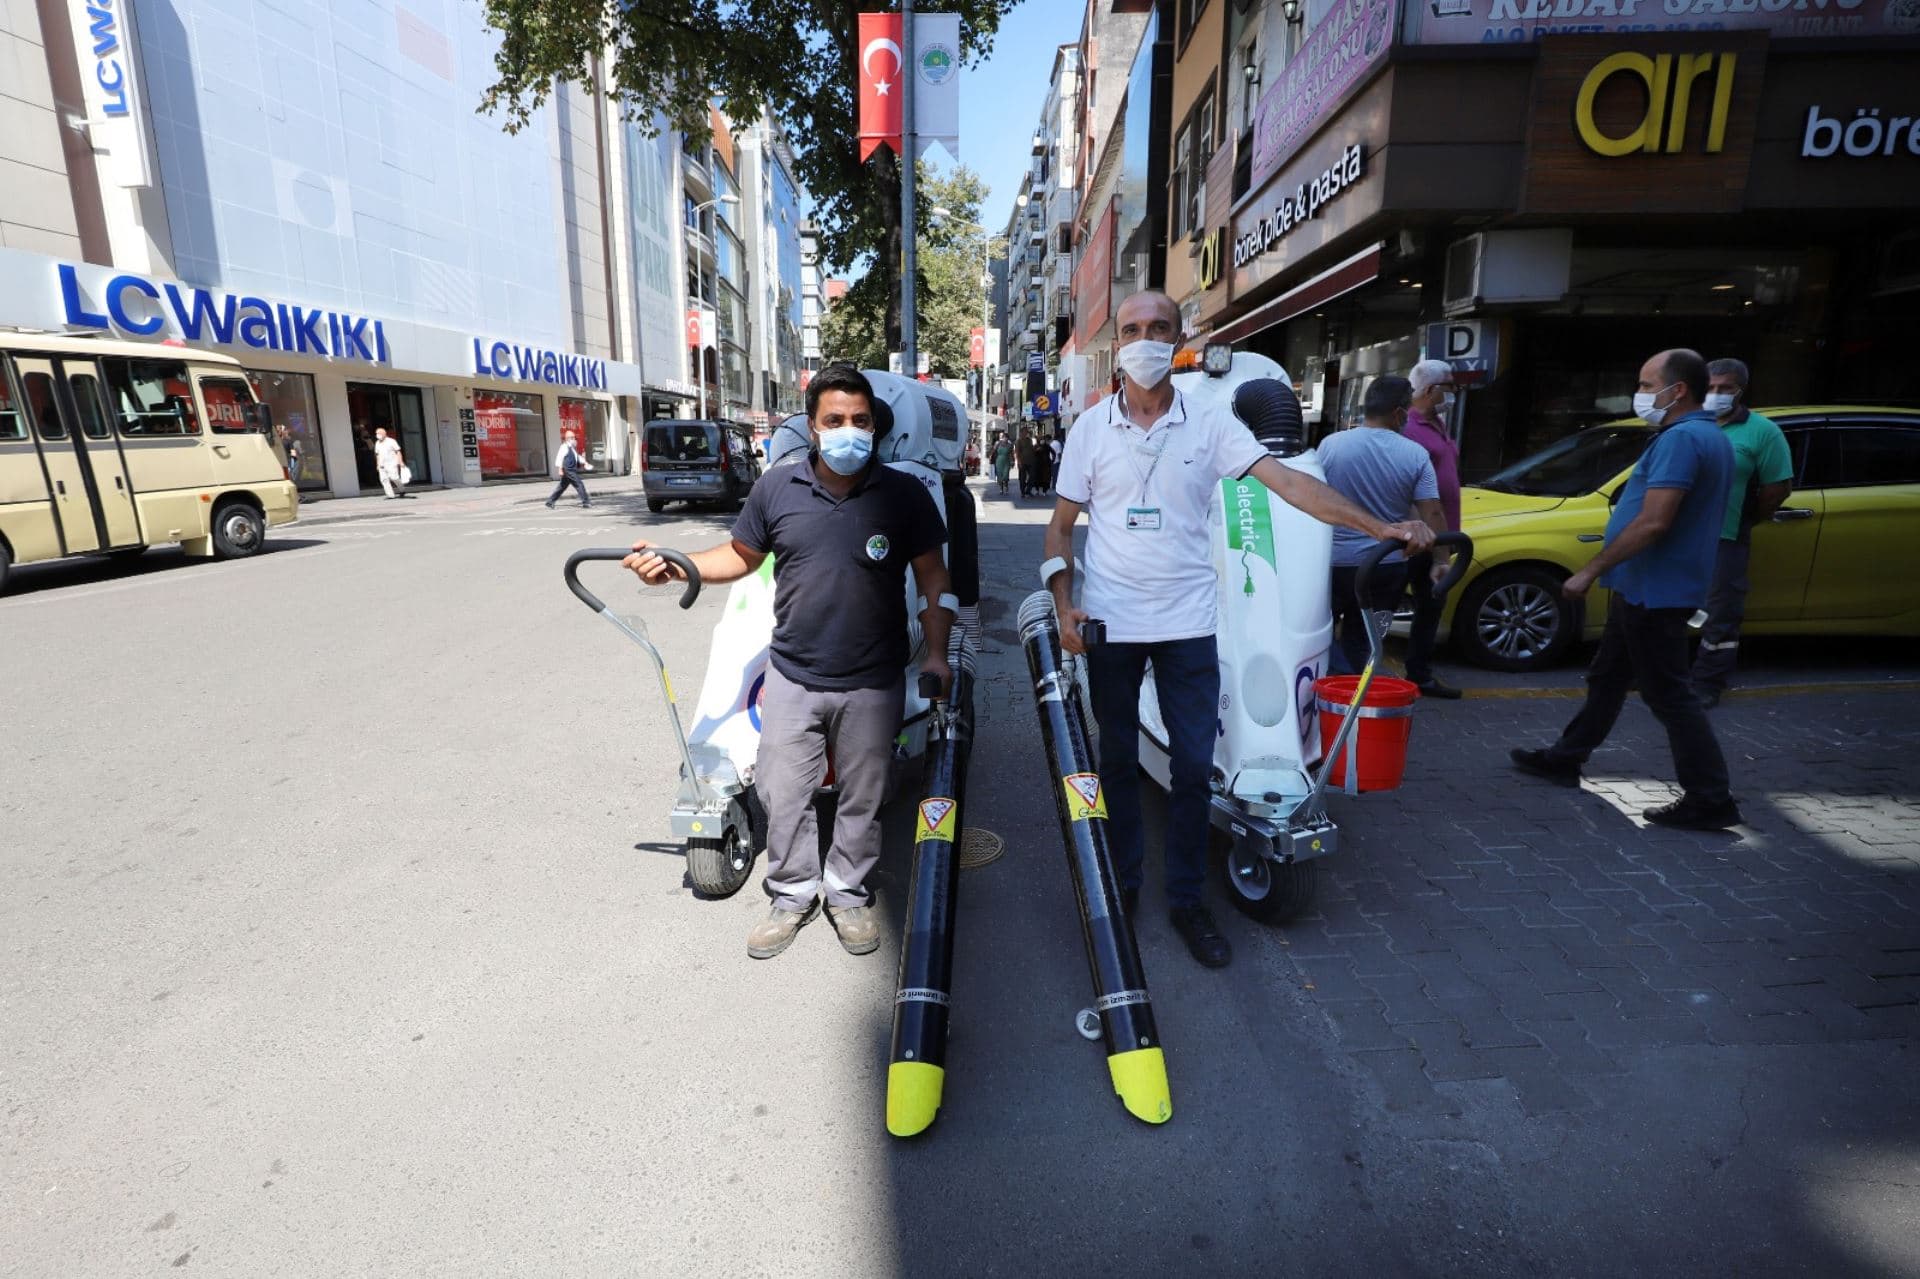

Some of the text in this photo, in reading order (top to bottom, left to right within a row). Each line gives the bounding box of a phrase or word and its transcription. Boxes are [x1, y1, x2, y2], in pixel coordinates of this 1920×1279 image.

[1308, 144, 1361, 220] pasta
[1447, 326, 1475, 357] D
[1236, 485, 1260, 553] electric
